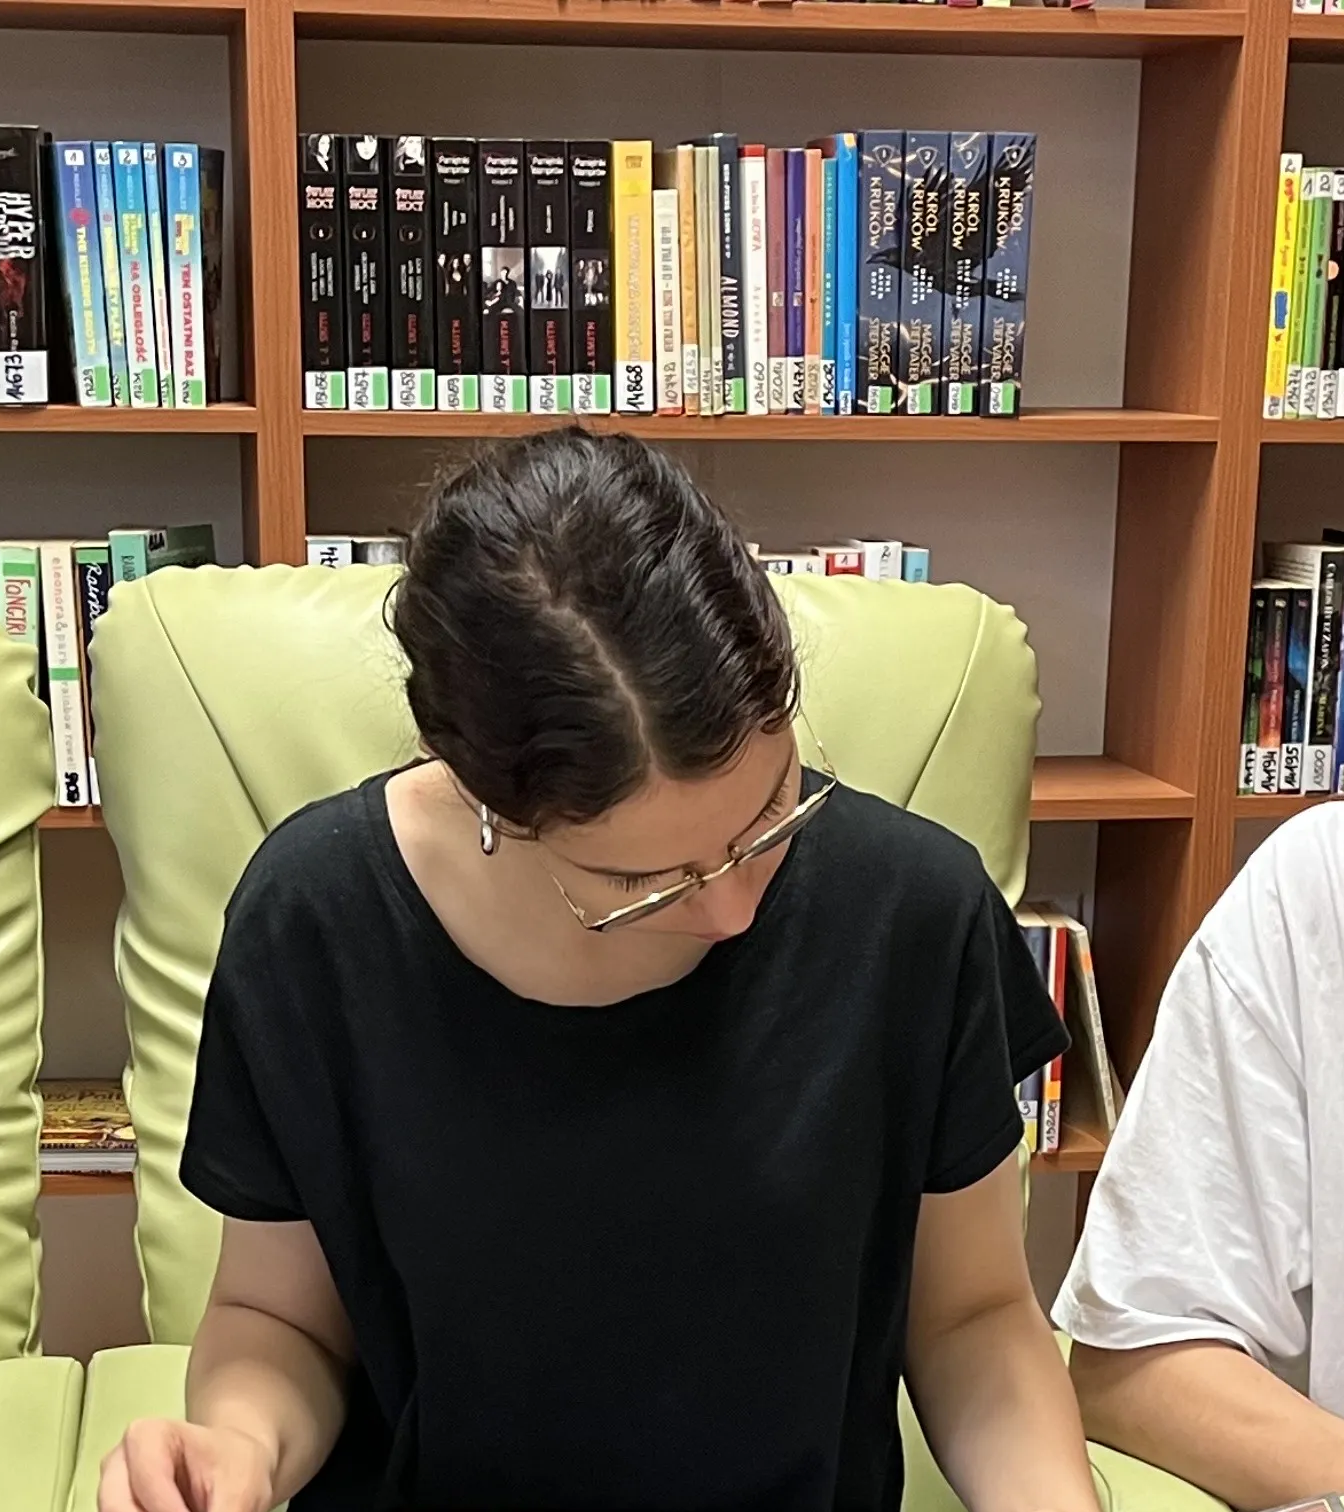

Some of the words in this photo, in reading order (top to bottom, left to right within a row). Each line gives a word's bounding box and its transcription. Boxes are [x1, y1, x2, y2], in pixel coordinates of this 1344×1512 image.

[1319, 174, 1331, 193] 2
[1, 192, 35, 260] HYPER
[868, 176, 883, 249] KRUKÓW
[882, 190, 896, 236] KRÓL
[911, 178, 926, 251] KRUKÓW
[925, 191, 939, 237] KRÓL
[952, 178, 967, 252] KRUKÓW
[967, 191, 981, 237] KRÓL
[995, 176, 1010, 251] KRUKÓW
[1011, 190, 1024, 236] KRÓL
[180, 263, 192, 290] TEN
[182, 291, 194, 344] OSTATNI
[721, 275, 739, 338] ALMOND
[184, 346, 195, 377] RAZ
[625, 365, 643, 409] 14868
